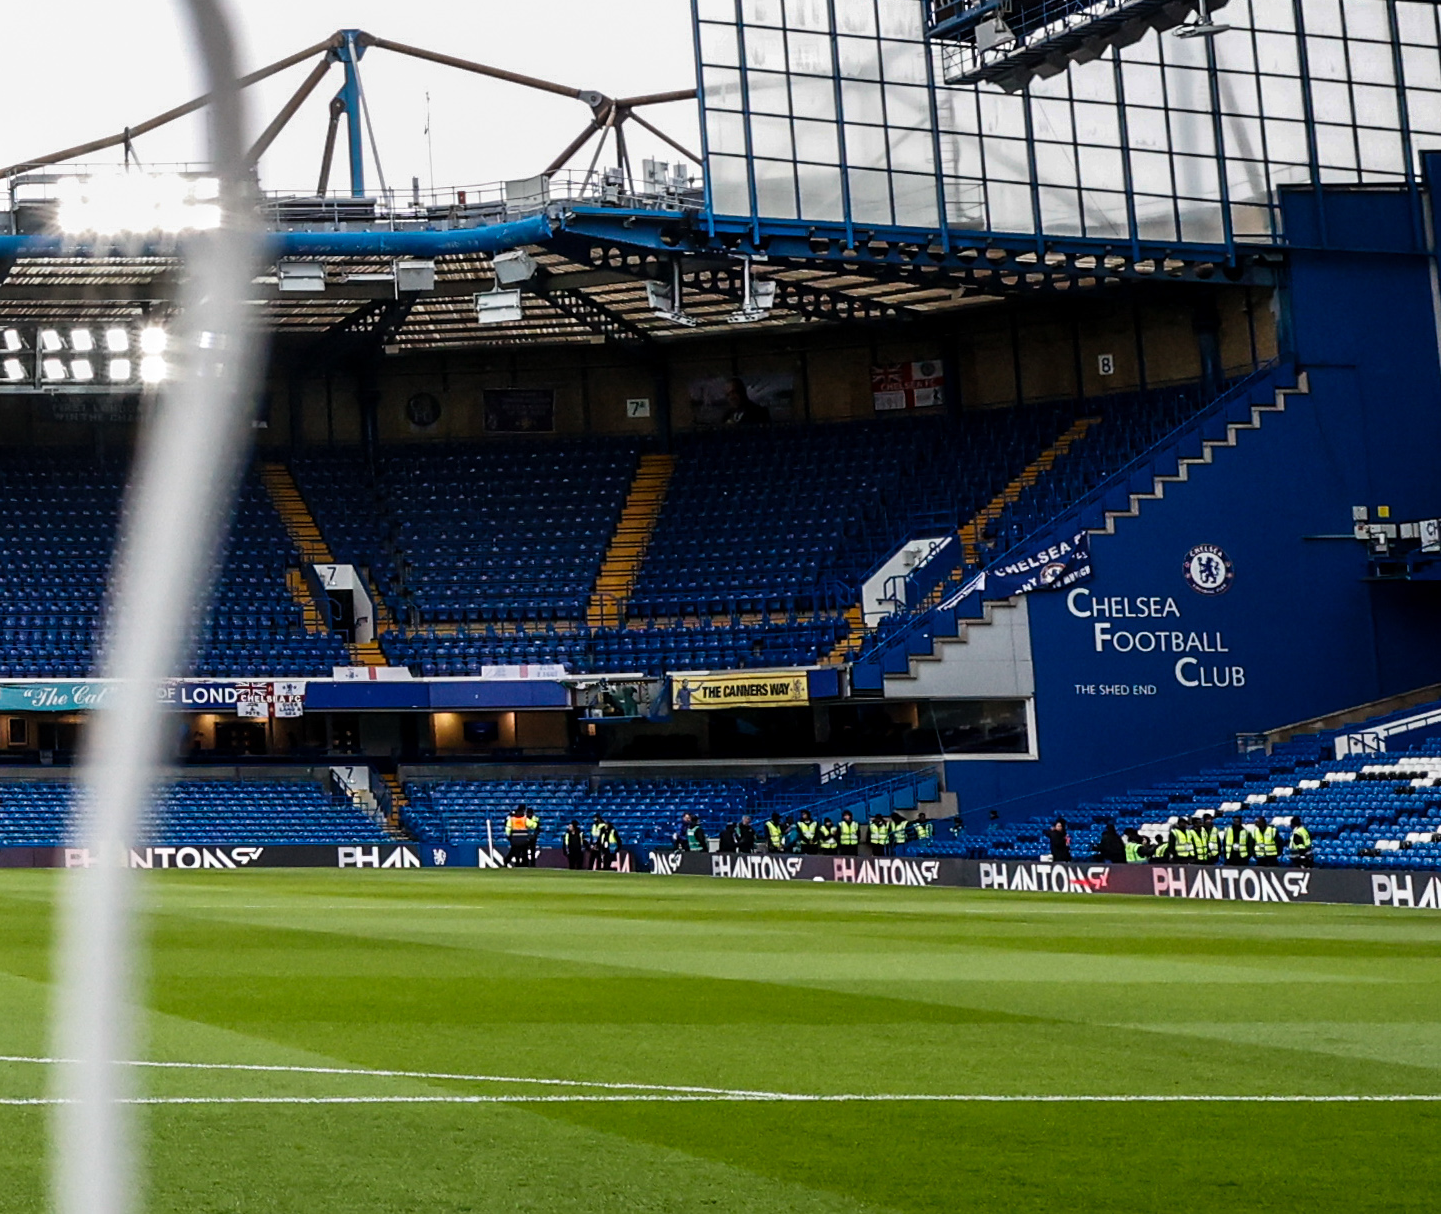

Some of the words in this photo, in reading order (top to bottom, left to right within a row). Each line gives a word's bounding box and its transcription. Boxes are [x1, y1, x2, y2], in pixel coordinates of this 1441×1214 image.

[1102, 357, 1110, 373] 8
[1190, 544, 1223, 558] CHELSEA
[994, 541, 1072, 577] CHELSEA
[327, 566, 337, 581] 7
[1067, 587, 1180, 618] CHELSEA
[1094, 622, 1229, 652] FOOTBALL
[1174, 657, 1245, 687] CLUB
[157, 688, 176, 699] OF
[702, 686, 721, 699] THE
[769, 683, 790, 696] WAY
[1074, 685, 1096, 695] THE
[1099, 685, 1130, 696] SHED
[1133, 685, 1157, 695] END
[240, 695, 285, 704] CHELSEA
[288, 695, 301, 703] FC
[345, 767, 353, 779] 7
